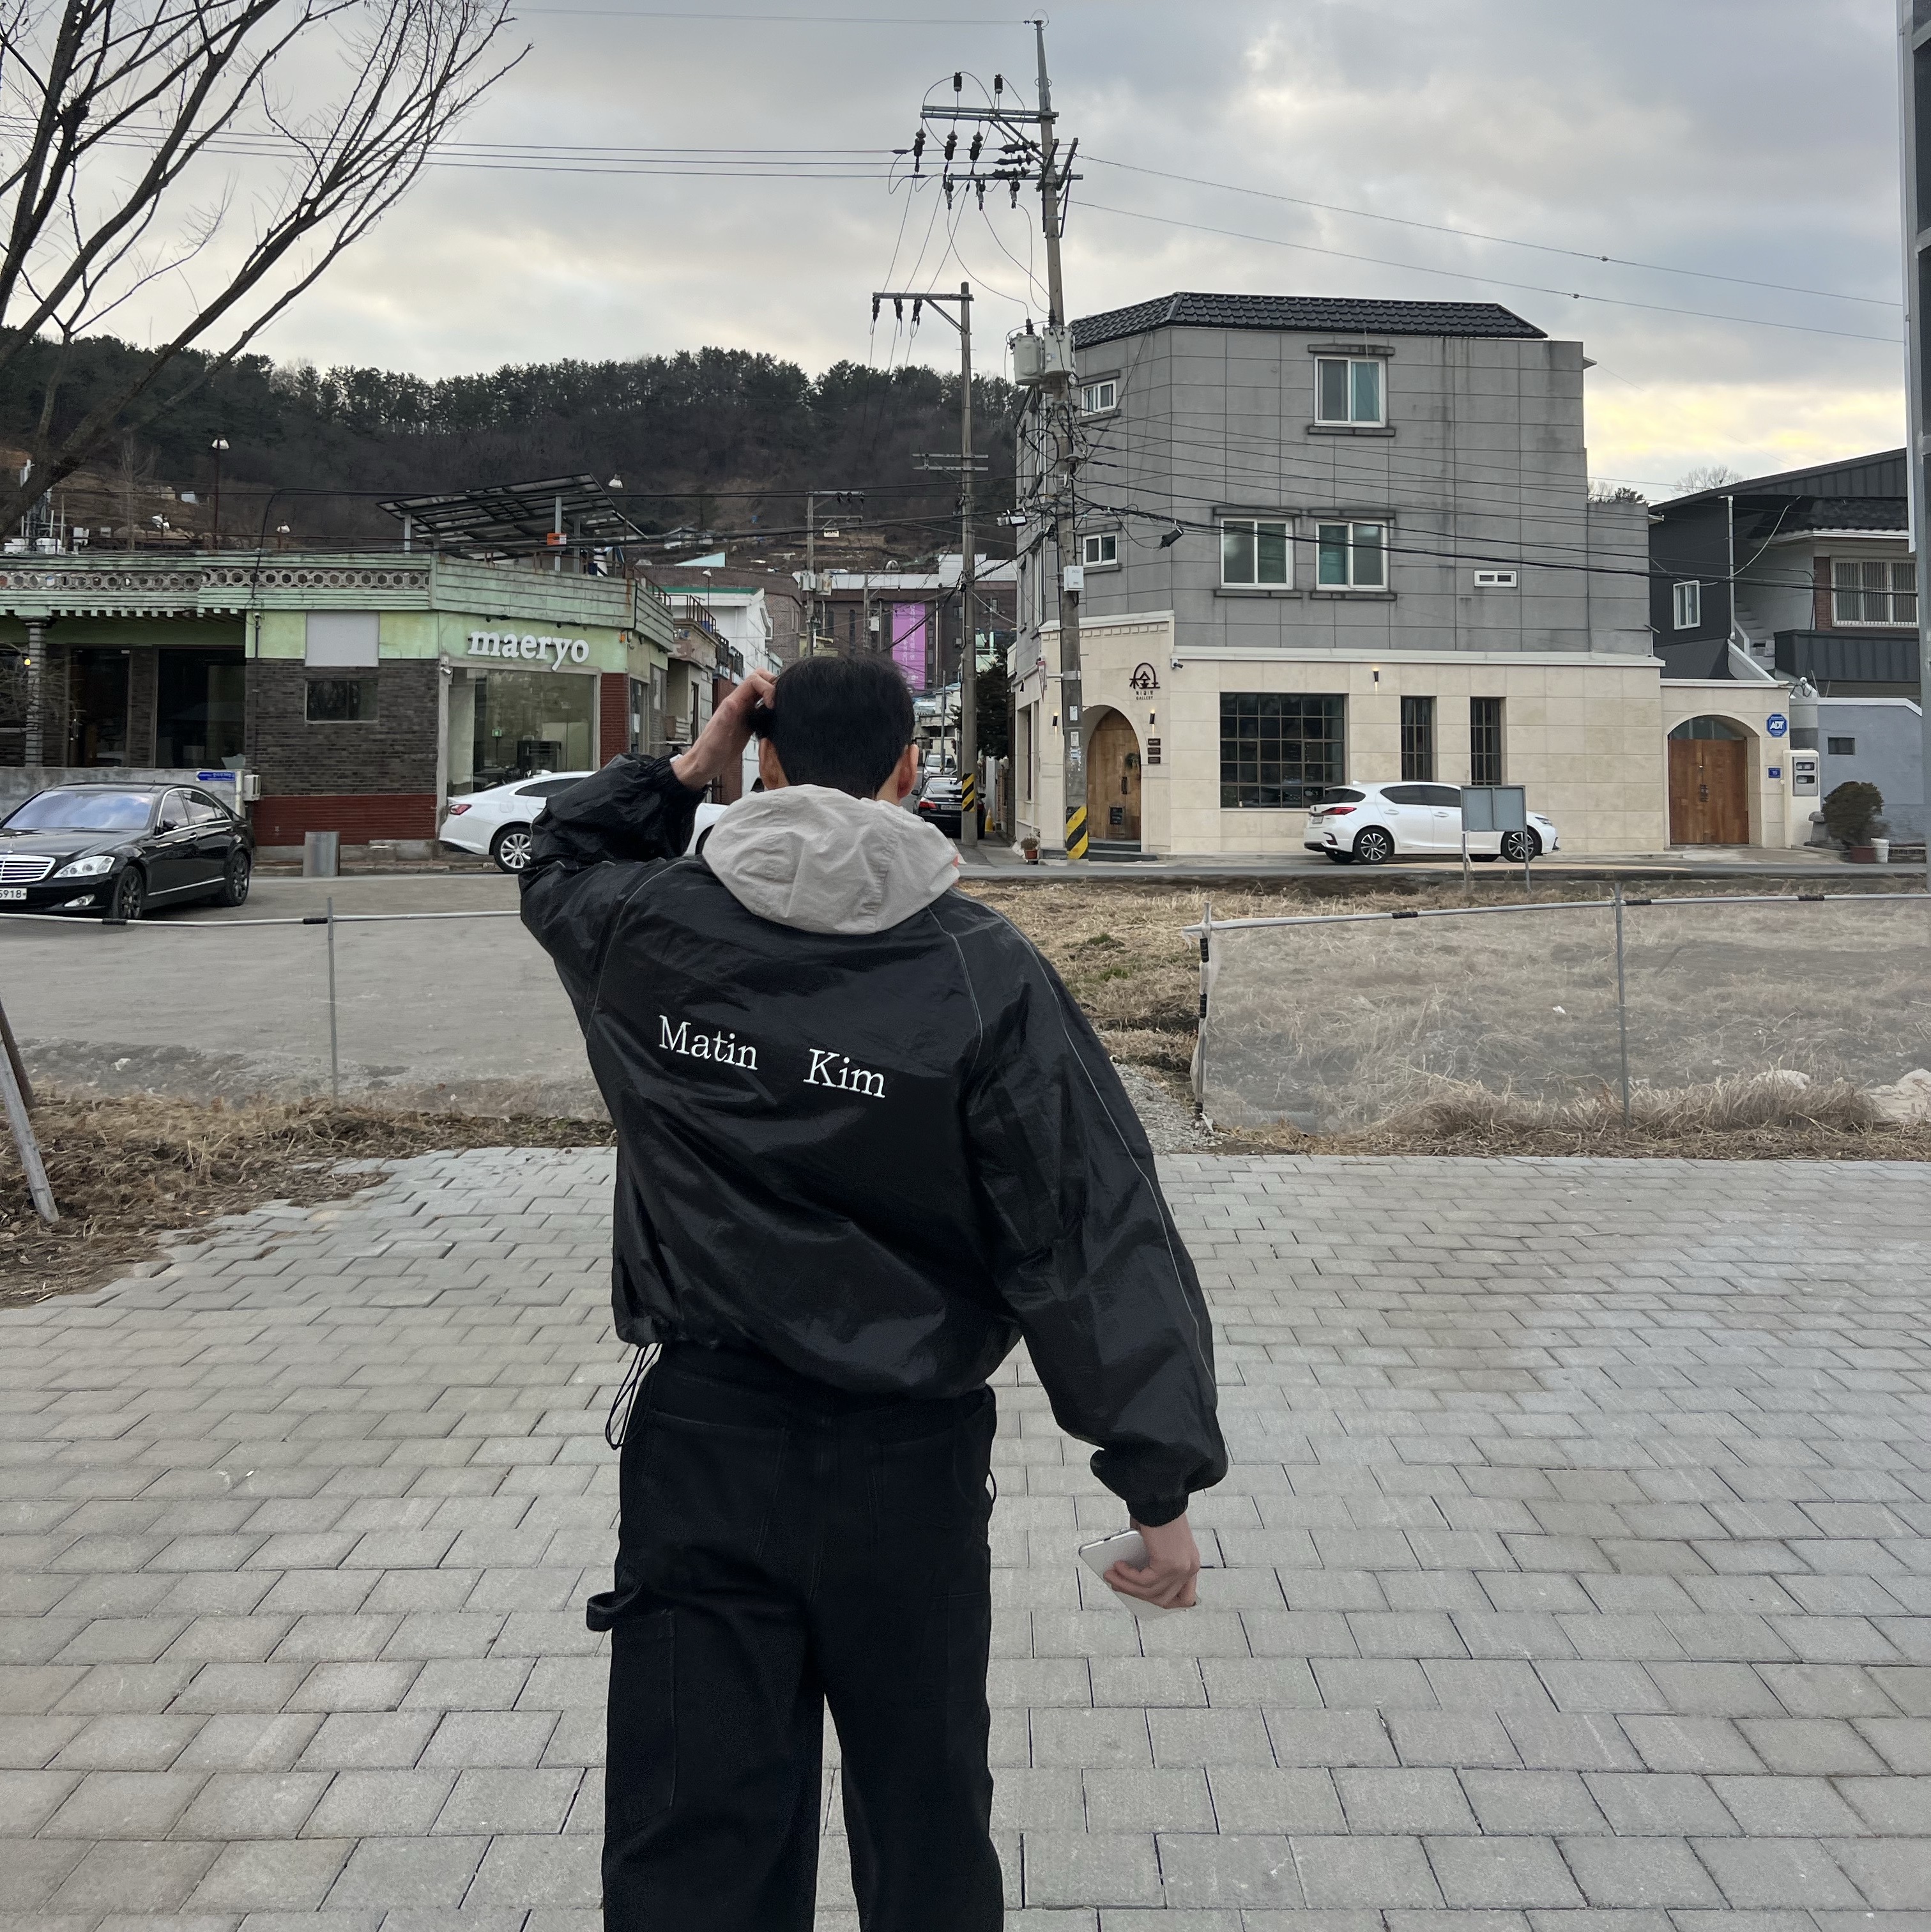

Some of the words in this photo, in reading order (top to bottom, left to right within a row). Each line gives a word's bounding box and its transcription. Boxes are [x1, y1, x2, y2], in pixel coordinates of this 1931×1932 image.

[468, 631, 590, 671] maeryo
[1769, 721, 1785, 730] ADT
[659, 1015, 758, 1071] Matin
[803, 1048, 886, 1099] Kim
